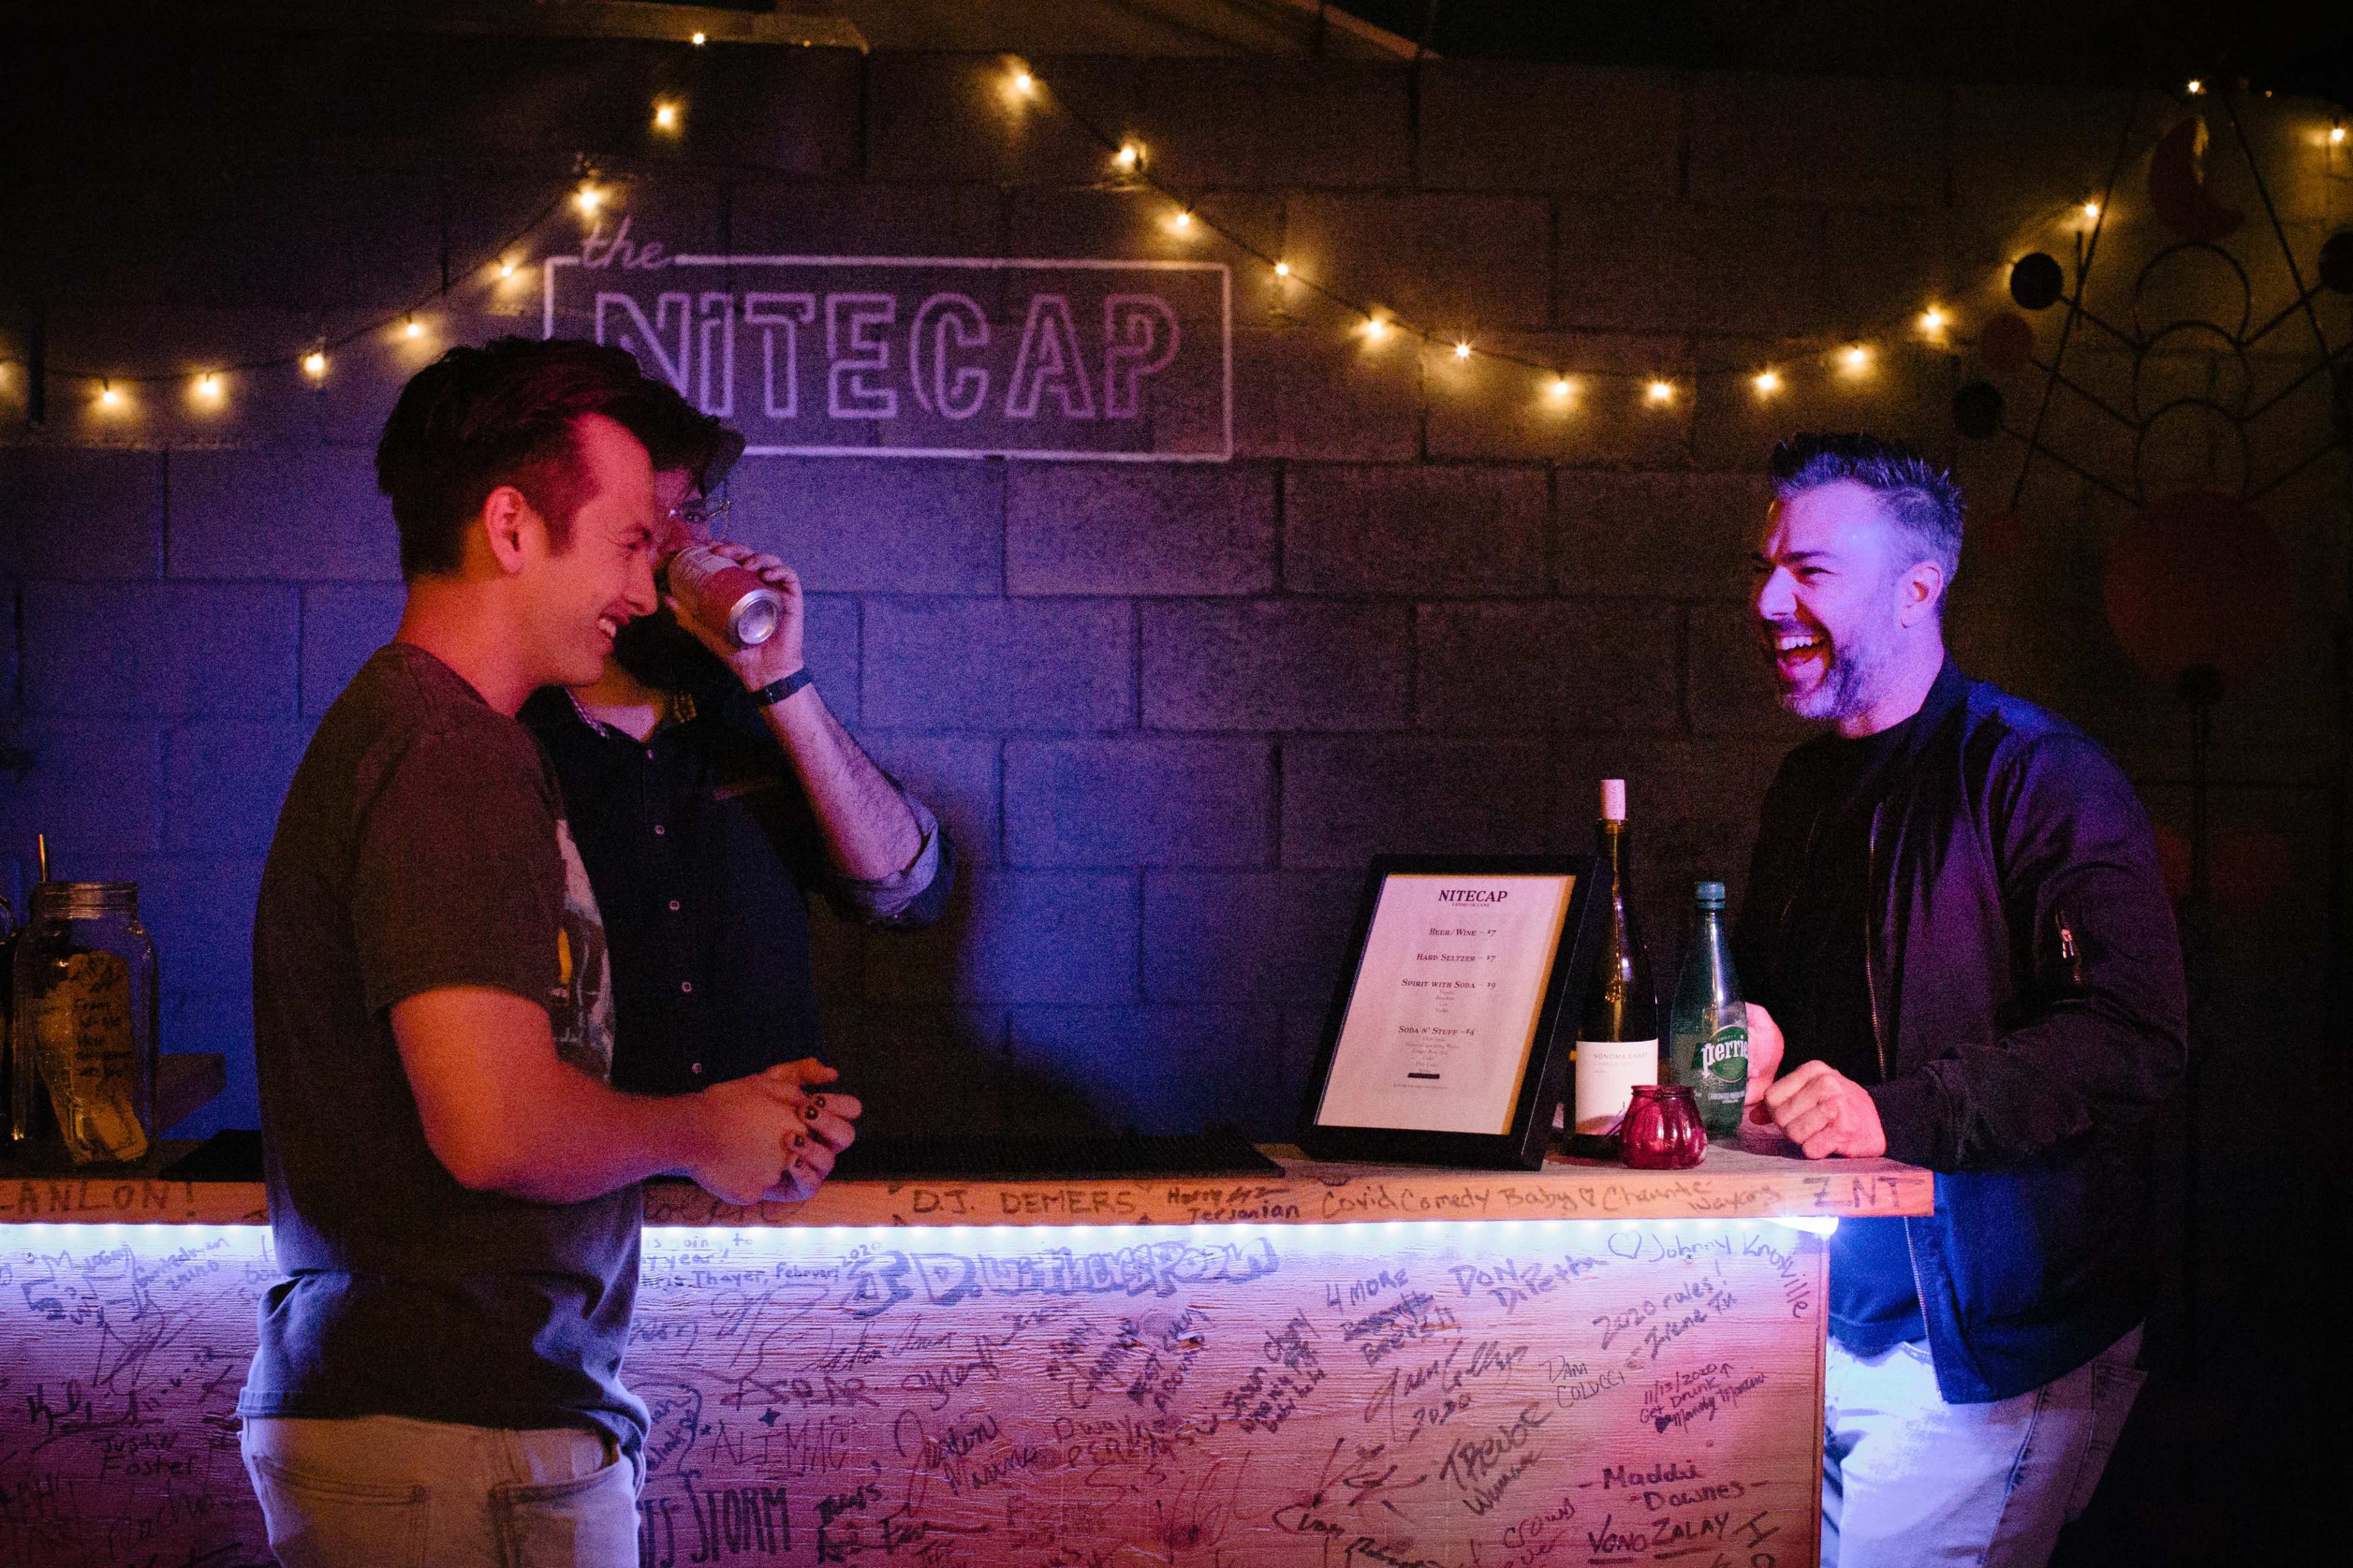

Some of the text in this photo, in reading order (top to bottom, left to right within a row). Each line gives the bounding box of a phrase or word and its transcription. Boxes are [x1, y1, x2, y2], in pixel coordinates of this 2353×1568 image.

[581, 216, 673, 271] the
[594, 291, 1181, 419] NITECAP
[1438, 890, 1508, 903] NITECAP
[0, 1180, 195, 1216] ANLON!
[1001, 1188, 1139, 1215] DEMERS
[1322, 1184, 1578, 1219] Covid Comedy Baby
[1349, 1267, 1409, 1306] MORE
[1648, 1233, 1811, 1318] Johnny Knoxville
